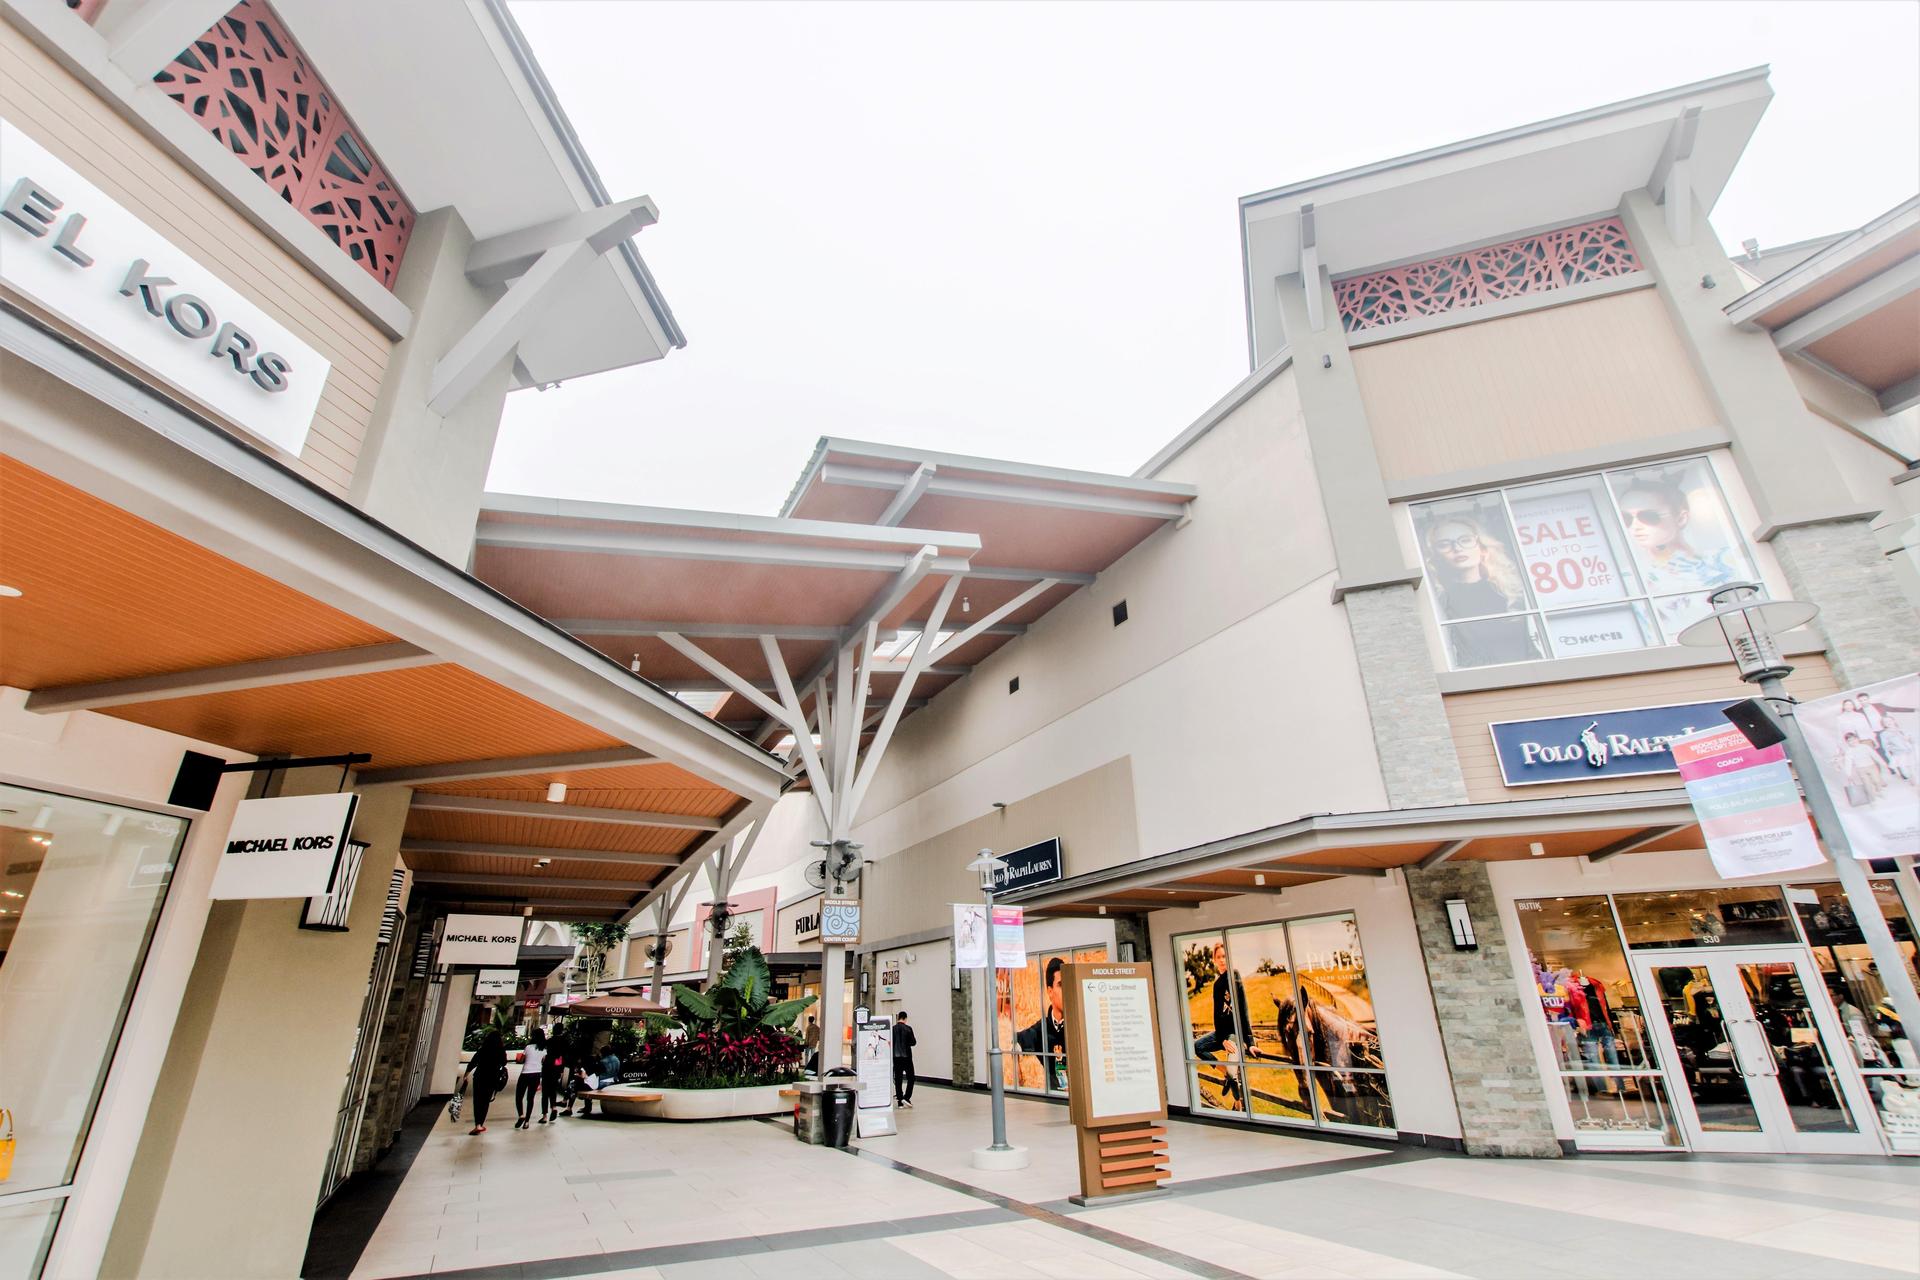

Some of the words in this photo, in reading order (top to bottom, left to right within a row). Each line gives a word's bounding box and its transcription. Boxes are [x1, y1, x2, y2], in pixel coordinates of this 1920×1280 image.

[119, 258, 293, 393] KORS
[1517, 516, 1595, 546] SALE
[1541, 547, 1559, 557] UP
[1562, 543, 1582, 554] TO
[1587, 574, 1613, 587] OFF
[1716, 756, 1744, 768] COACH
[226, 839, 288, 854] MICHAEL
[292, 836, 334, 850] KORS
[1009, 865, 1028, 880] RALPH
[1028, 859, 1052, 874] LAUREN
[1518, 902, 1542, 911] BUTIK
[795, 912, 820, 935] FURLA
[446, 934, 488, 943] MICHAEL
[491, 936, 517, 944] KORS
[1703, 935, 1721, 944] 530
[1092, 968, 1114, 976] MIDDLE
